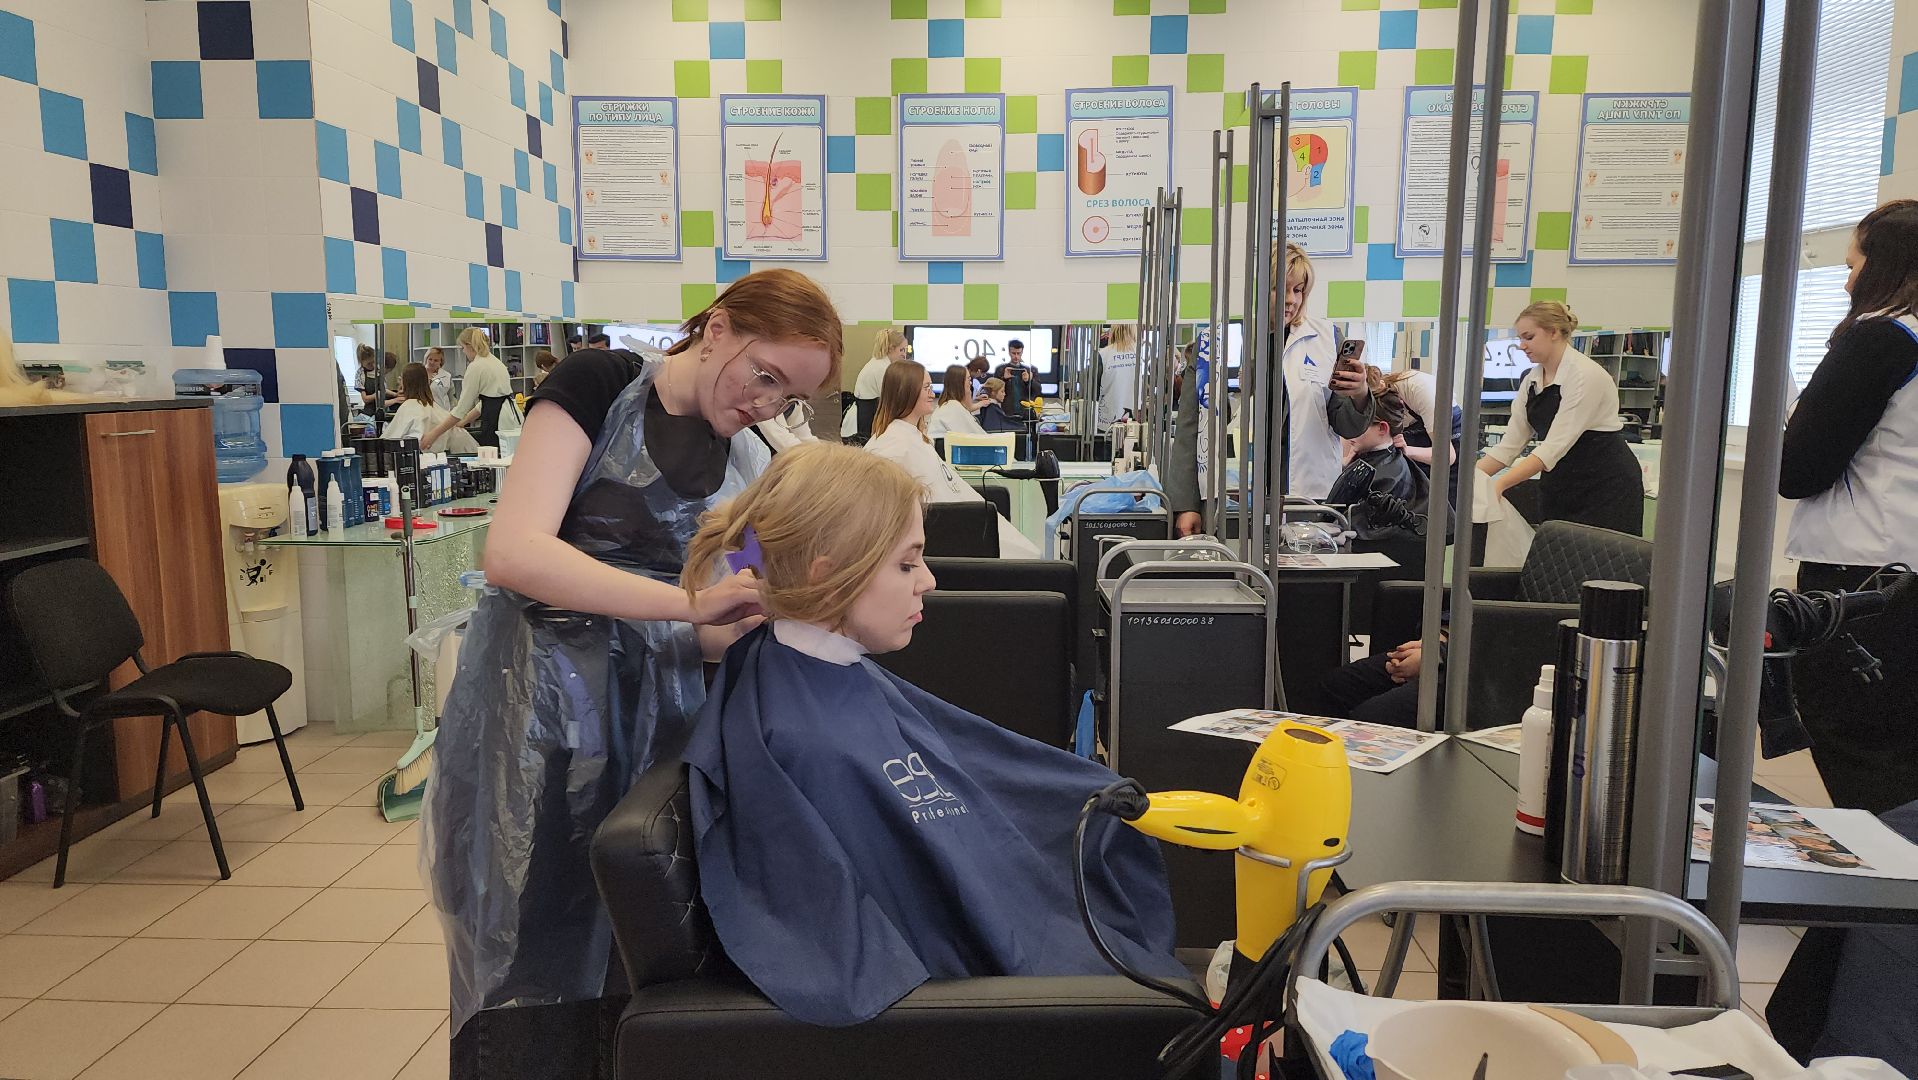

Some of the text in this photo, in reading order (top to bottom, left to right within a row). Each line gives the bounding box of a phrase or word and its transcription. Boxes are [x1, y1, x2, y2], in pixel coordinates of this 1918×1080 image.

[601, 102, 649, 112] СТРИЖКИ
[1073, 98, 1165, 111] СТРОЕНИЕ ВОЛОСА
[1296, 100, 1340, 111] ГОЛОВЫ
[729, 106, 815, 118] СТРОЕНИЕ КОЖИ
[908, 105, 996, 117] СТРОЕНИЕ НОГТЯ
[589, 113, 663, 123] ПО ТИПУ ЛИЦА
[1295, 137, 1300, 145] 3
[1300, 152, 1305, 160] 4
[1086, 199, 1151, 208] СРЕЗ ВОЛОСА
